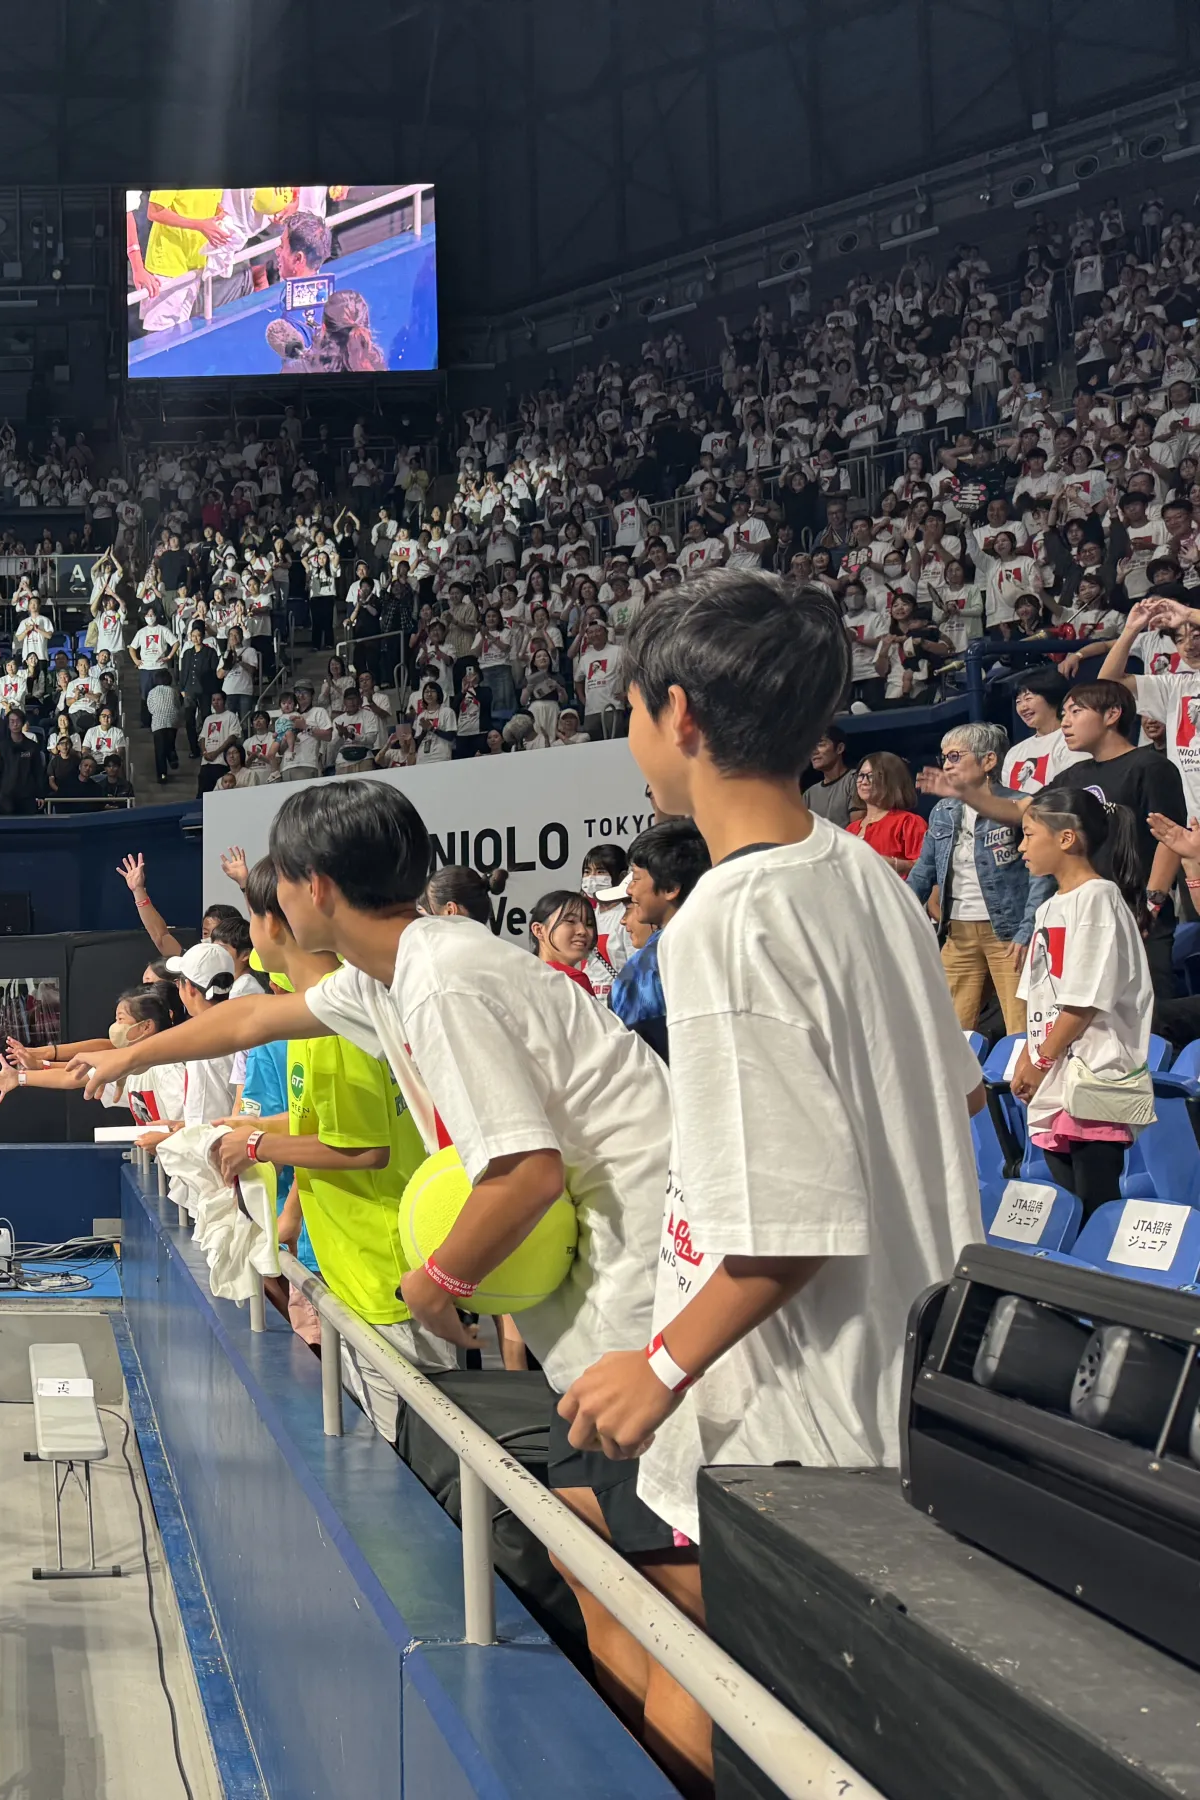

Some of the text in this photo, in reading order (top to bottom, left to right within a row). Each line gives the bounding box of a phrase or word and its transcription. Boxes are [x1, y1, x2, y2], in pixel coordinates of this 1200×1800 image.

[69, 564, 86, 583] A
[584, 814, 655, 838] TOKY
[995, 847, 1018, 863] Roc
[1012, 1198, 1044, 1214] JTA招待
[1007, 1212, 1039, 1228] ジュニア
[1132, 1219, 1172, 1236] JTA招待
[1128, 1235, 1167, 1252] ジュニア
